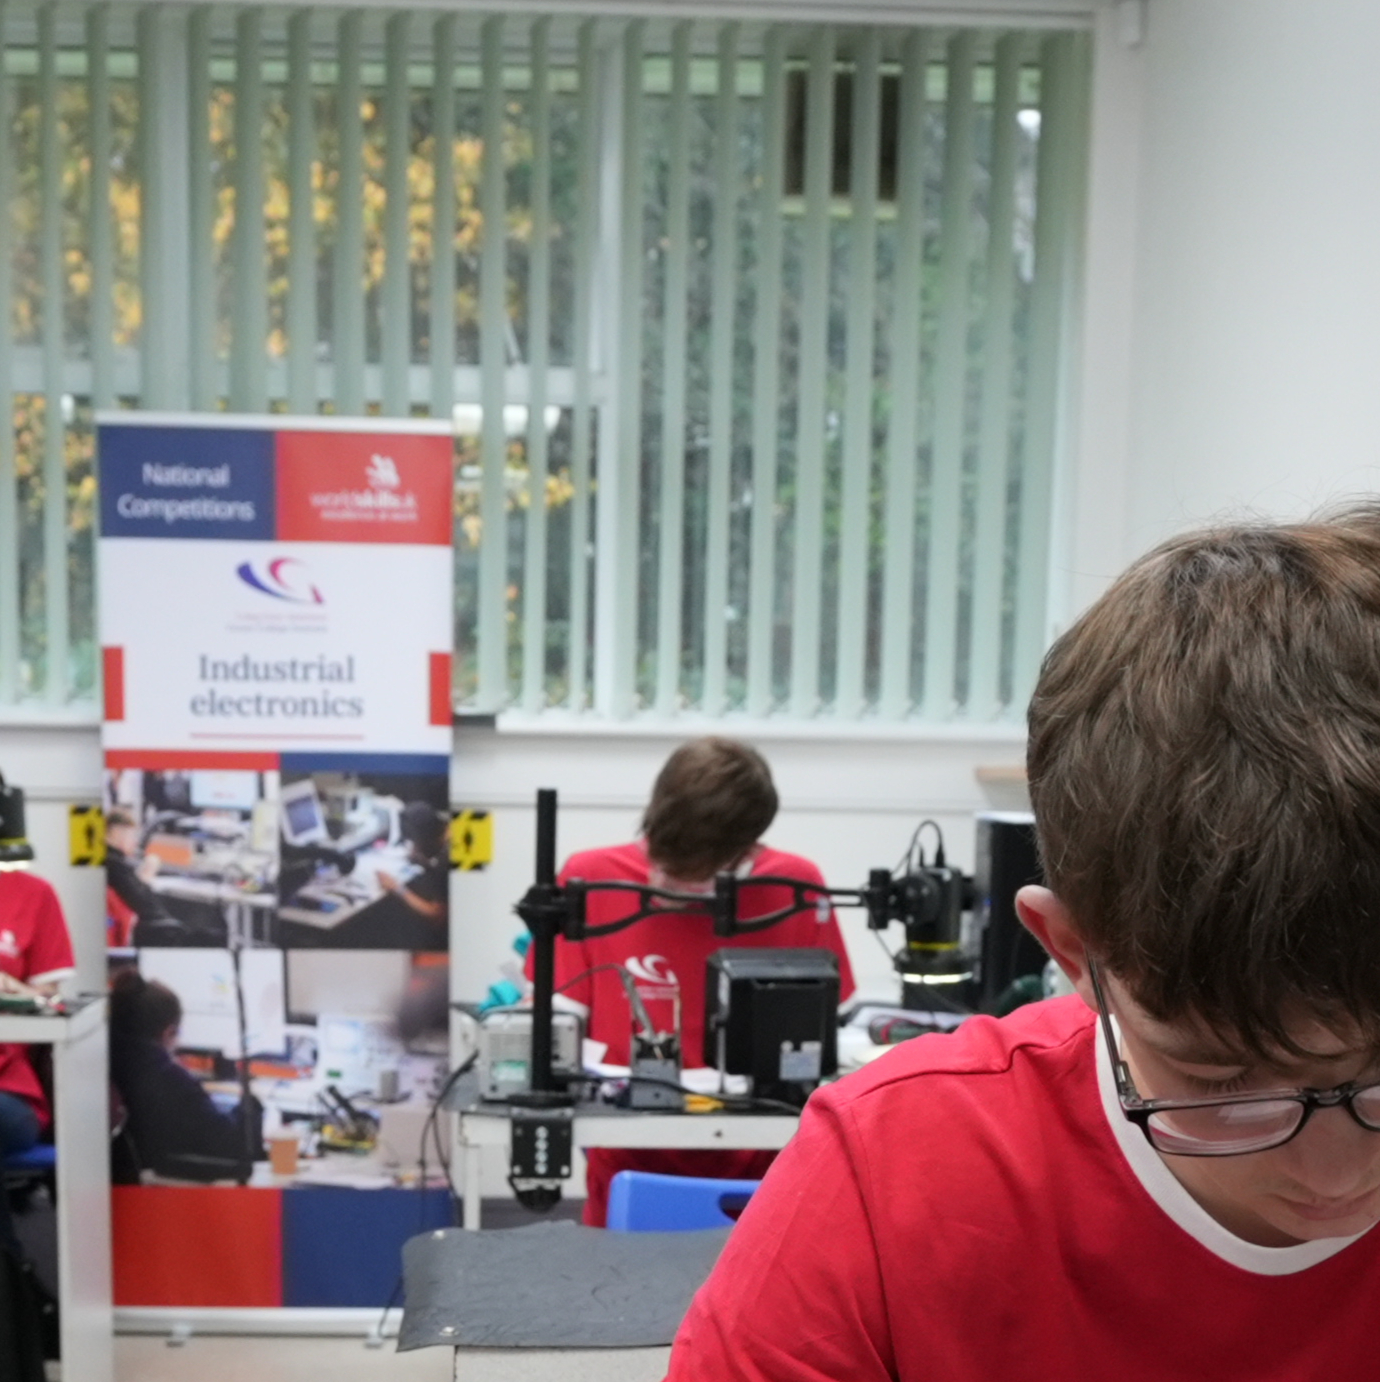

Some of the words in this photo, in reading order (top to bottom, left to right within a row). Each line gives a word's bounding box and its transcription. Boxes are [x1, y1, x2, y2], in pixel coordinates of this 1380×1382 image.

[141, 461, 231, 489] National
[117, 493, 256, 524] Competitions
[198, 653, 355, 683] Industrial
[189, 688, 365, 718] electronics
